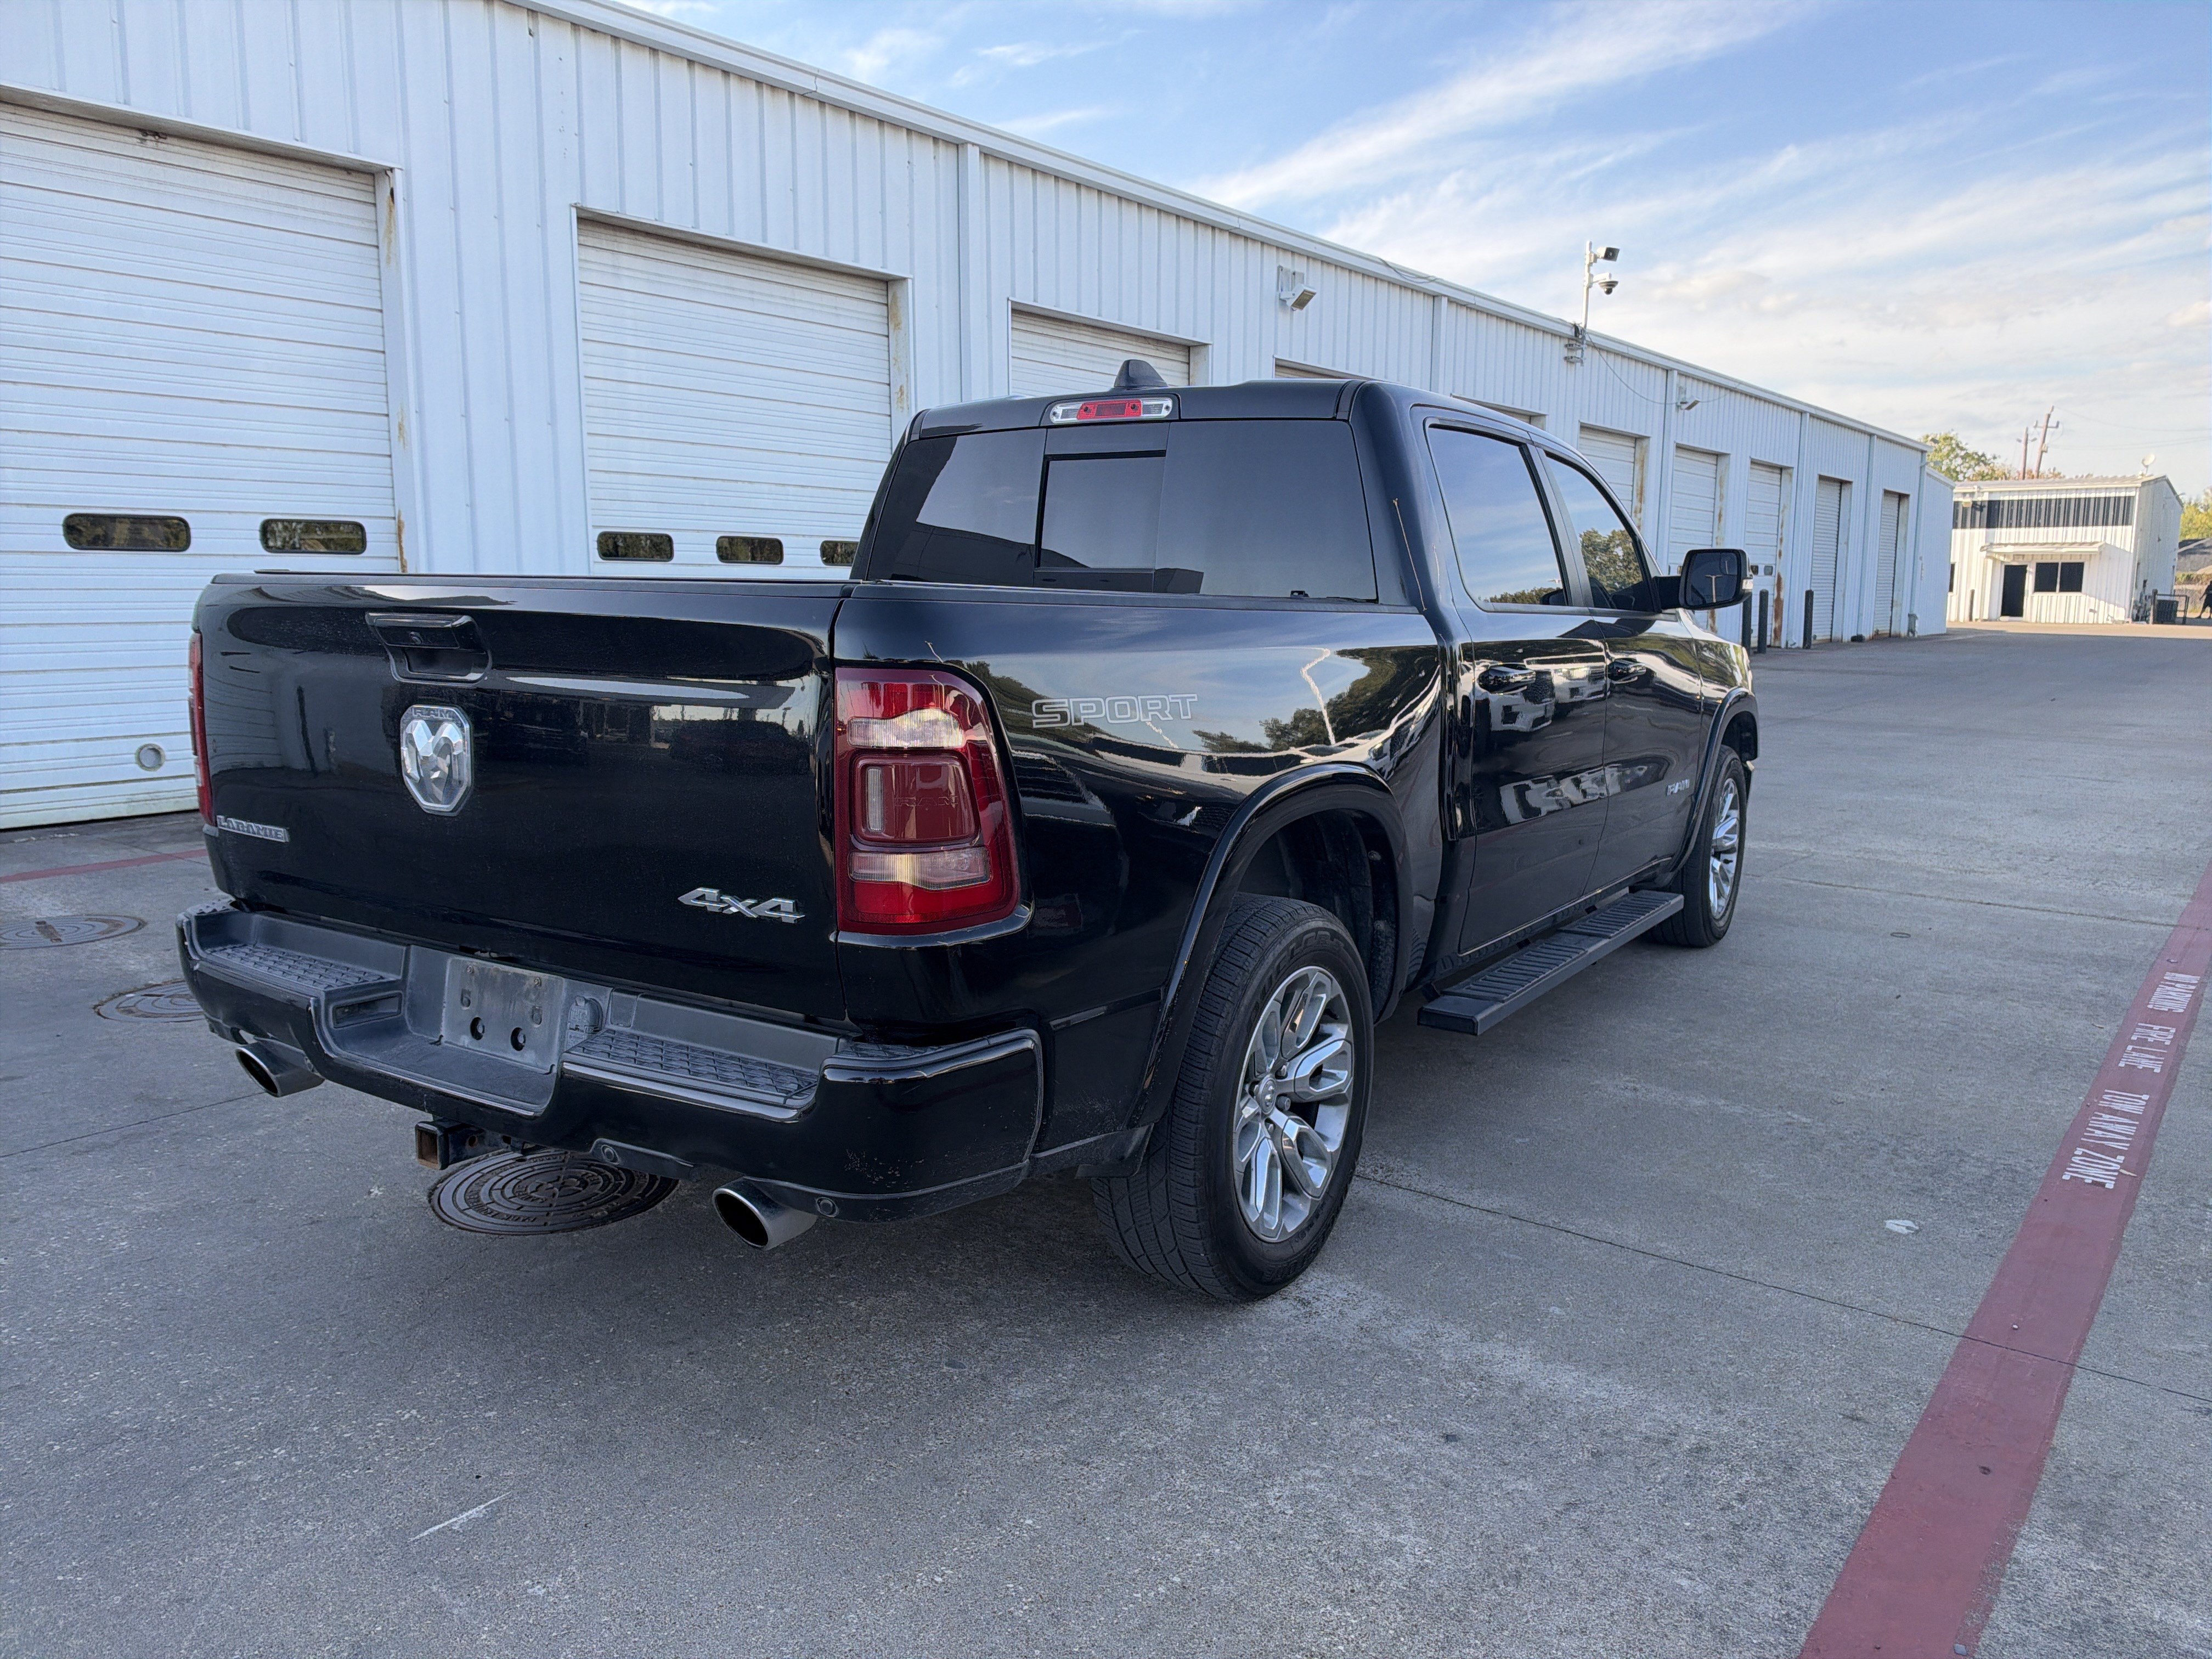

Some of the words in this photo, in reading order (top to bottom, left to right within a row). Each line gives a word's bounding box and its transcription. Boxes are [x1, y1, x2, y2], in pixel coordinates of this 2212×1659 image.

[1032, 693, 1198, 729] SPORT
[217, 815, 289, 842] LARAMIE
[2147, 981, 2196, 1013] PARKING
[2131, 1023, 2176, 1045] FIRE
[2118, 1045, 2168, 1073] LANE
[2098, 1090, 2149, 1115] TOW
[2081, 1111, 2139, 1150] AWAY
[2062, 1147, 2125, 1189] ZONE
